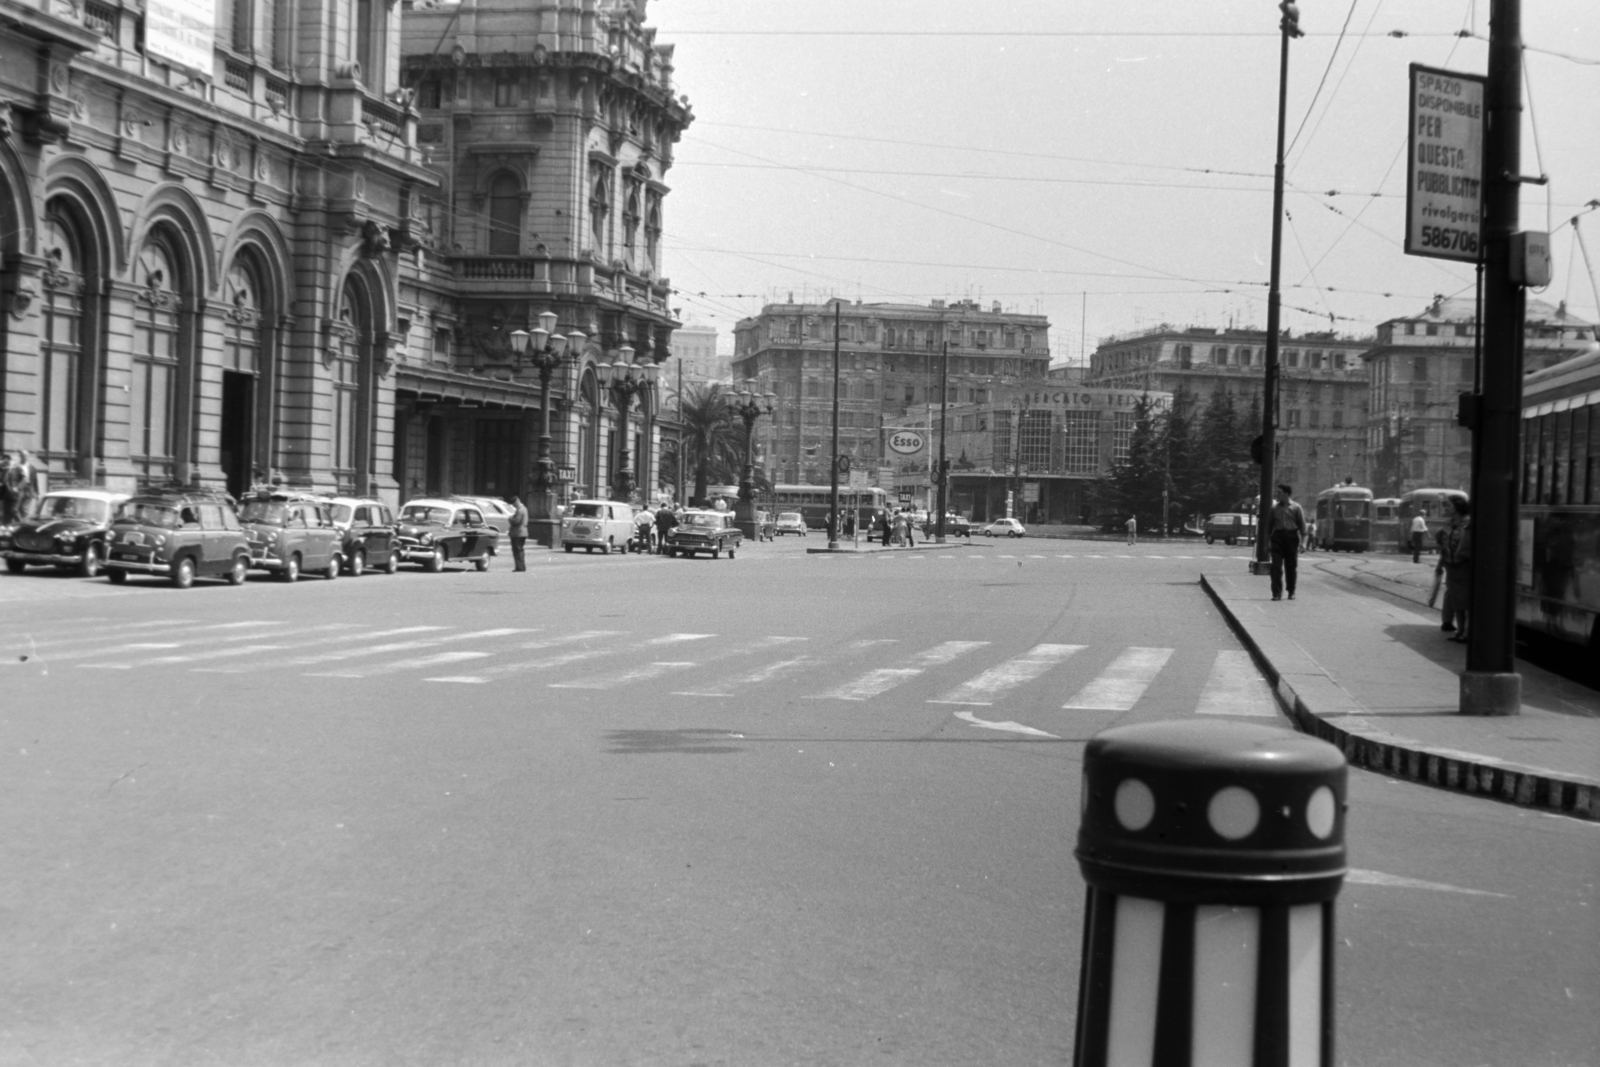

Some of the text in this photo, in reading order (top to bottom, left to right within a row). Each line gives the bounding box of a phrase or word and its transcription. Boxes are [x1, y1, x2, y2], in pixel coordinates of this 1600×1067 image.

[1419, 75, 1461, 96] SPAZIO
[1418, 93, 1480, 119] DISPONIBILE
[1418, 115, 1442, 138] PER
[1422, 202, 1479, 223] rivolgersi
[1421, 225, 1478, 253] 586706
[559, 469, 575, 480] TAXI
[900, 493, 911, 501] TAXI
